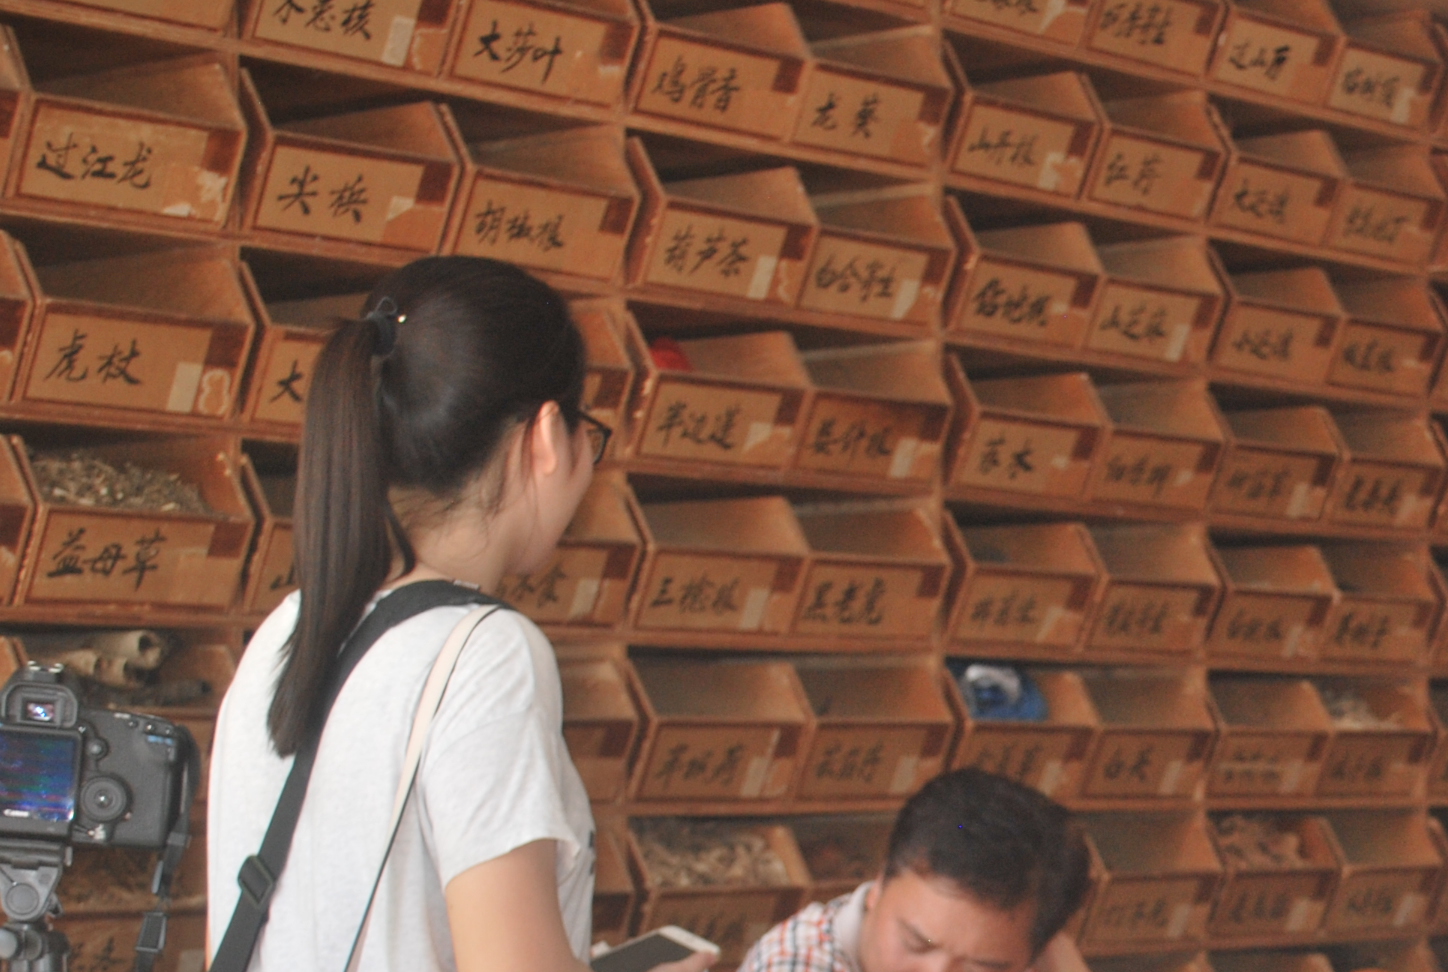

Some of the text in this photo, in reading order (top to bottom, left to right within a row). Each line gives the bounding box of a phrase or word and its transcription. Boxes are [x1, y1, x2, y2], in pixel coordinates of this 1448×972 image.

[36, 132, 153, 190] 过江龙
[46, 328, 142, 387] 虎杖
[46, 527, 168, 590] 益母草
